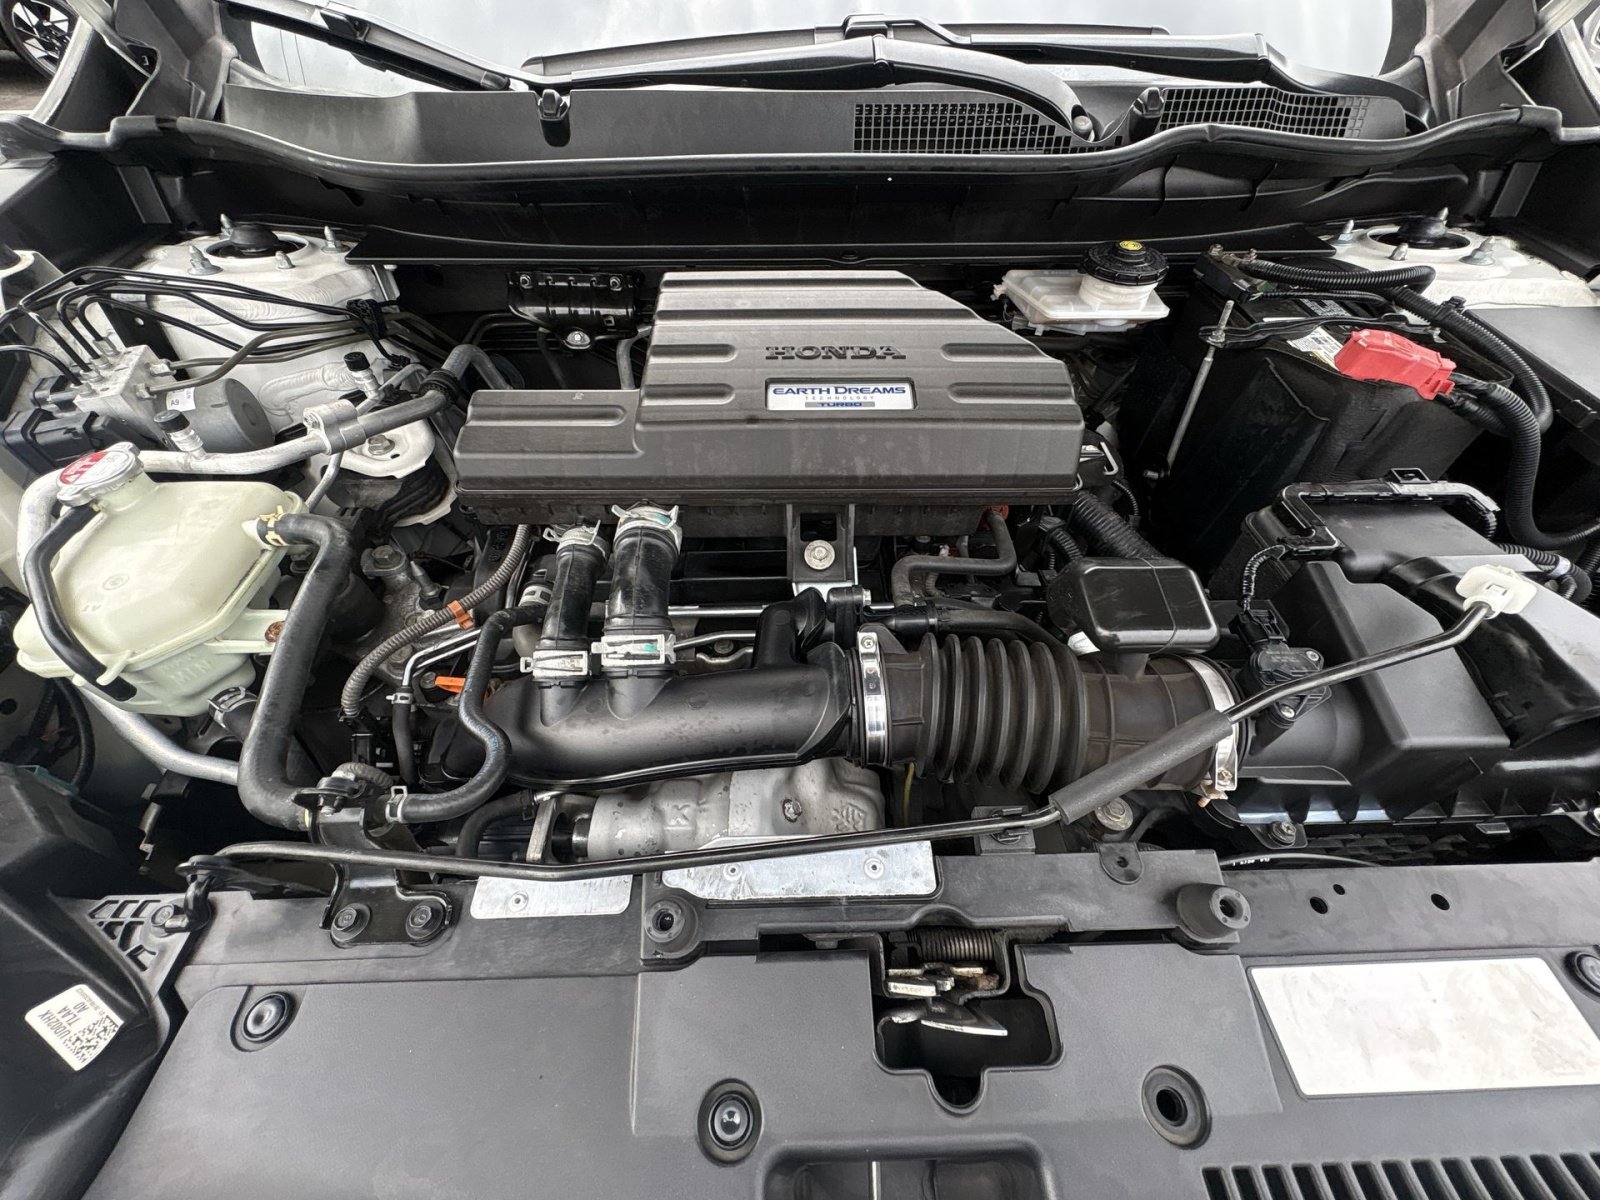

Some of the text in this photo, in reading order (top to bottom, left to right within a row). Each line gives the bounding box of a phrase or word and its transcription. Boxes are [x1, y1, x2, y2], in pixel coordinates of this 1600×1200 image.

[766, 345, 906, 360] HONDA
[772, 386, 906, 395] EARTH DREAMS
